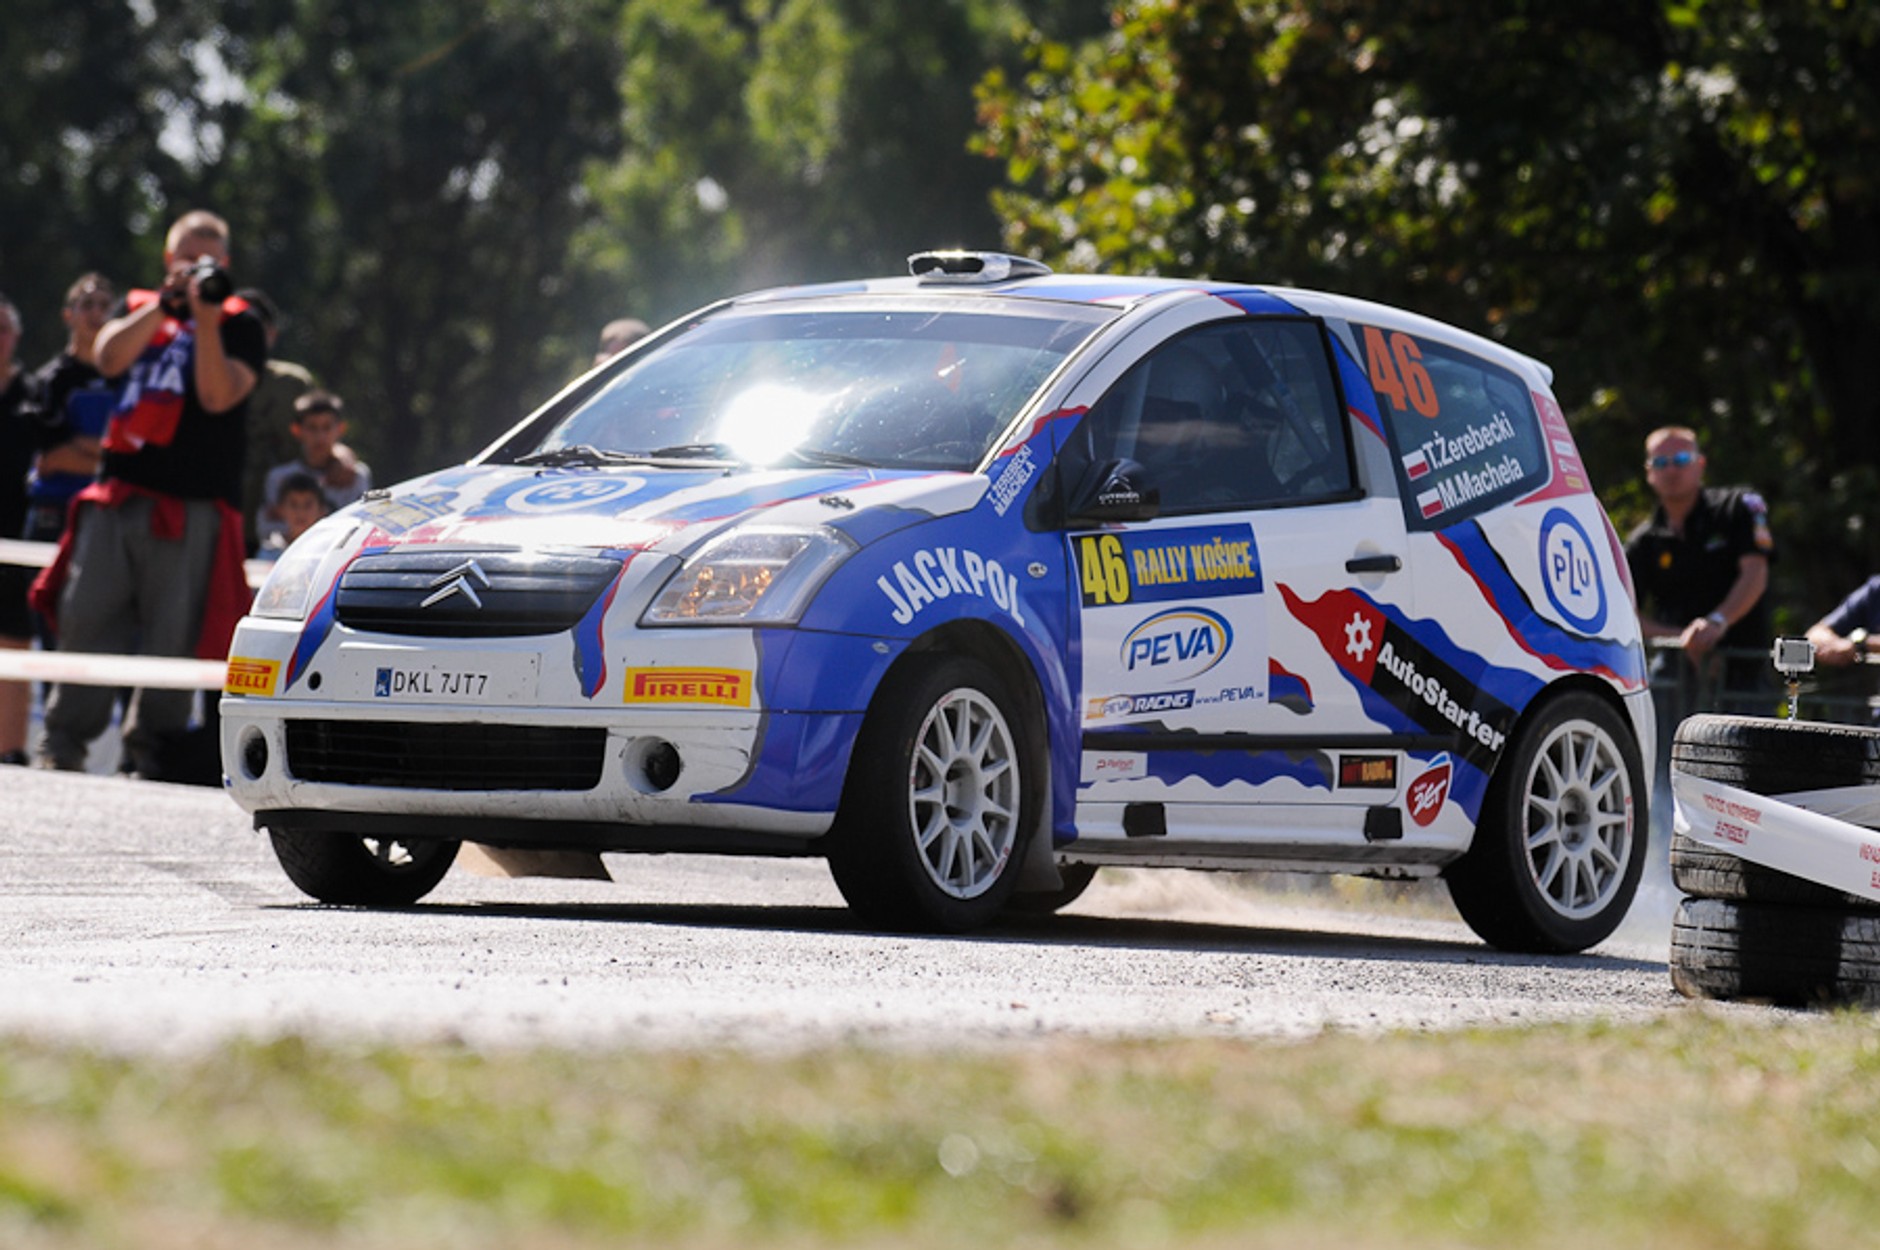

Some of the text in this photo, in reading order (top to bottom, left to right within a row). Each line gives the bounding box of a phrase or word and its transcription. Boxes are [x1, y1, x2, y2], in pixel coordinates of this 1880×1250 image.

[1362, 324, 1440, 419] 46
[1422, 408, 1516, 471] T.Żerebecki
[1437, 454, 1525, 511] M.Machela
[876, 547, 1026, 628] JACKPOL
[1081, 534, 1130, 605] 46
[1132, 536, 1255, 586] RALLY KOŠICE
[1553, 539, 1591, 597] PZU
[1128, 625, 1215, 672] PEVA
[393, 671, 488, 696] DKL 7JT7
[633, 672, 741, 700] PIRELLI
[1135, 694, 1188, 712] RACING
[1376, 641, 1506, 752] AutoStarter
